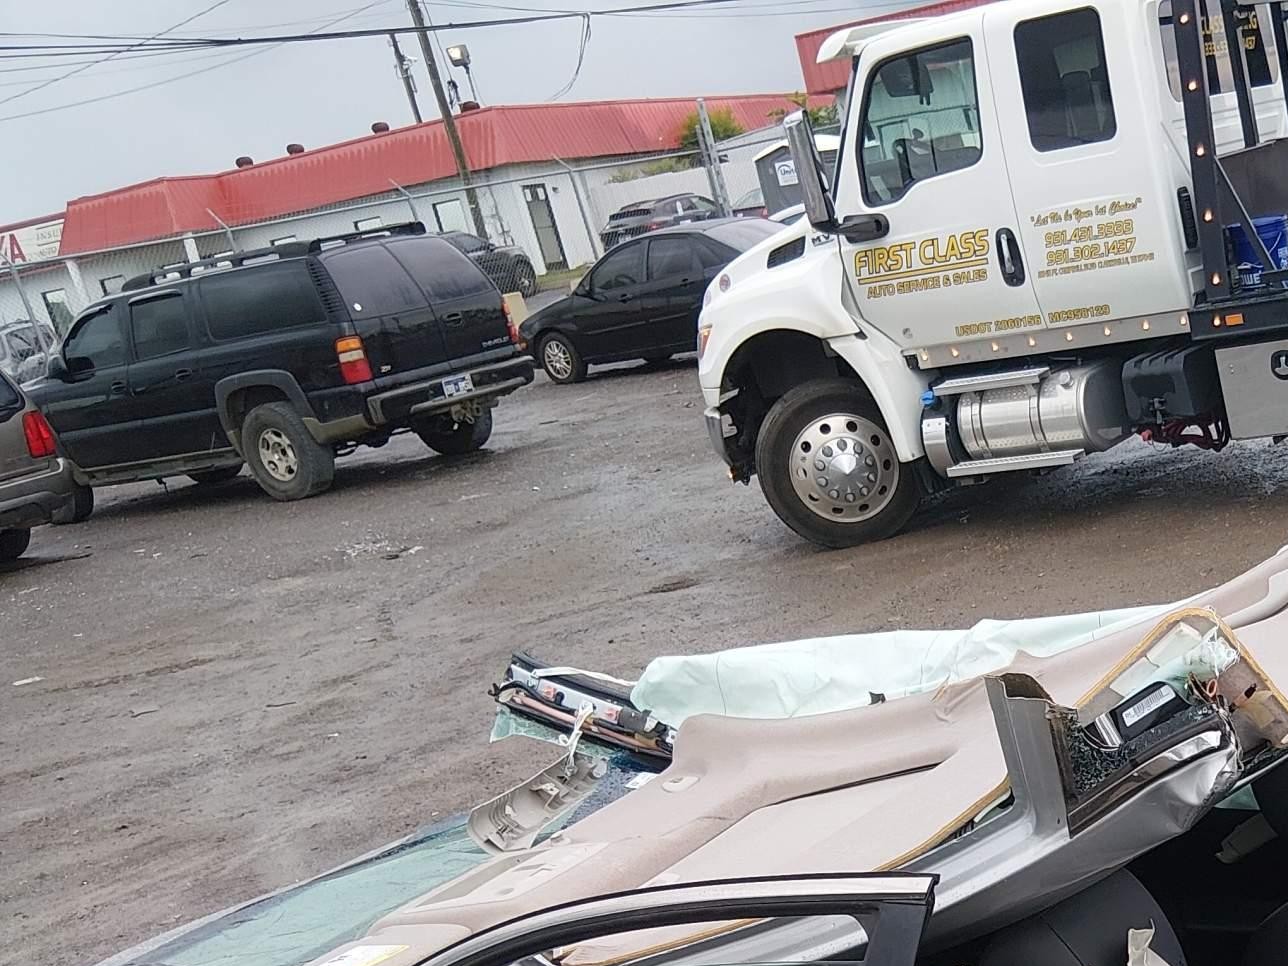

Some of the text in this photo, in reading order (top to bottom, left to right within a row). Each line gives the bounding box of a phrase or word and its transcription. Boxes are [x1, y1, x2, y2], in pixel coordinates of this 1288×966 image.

[1045, 219, 1134, 248] 931.431.3333
[855, 229, 990, 277] FIRST CLASS
[1047, 237, 1136, 266] 931.302.1437
[867, 268, 988, 299] AUTO SERVICE & SALES
[955, 322, 993, 337] USDOT
